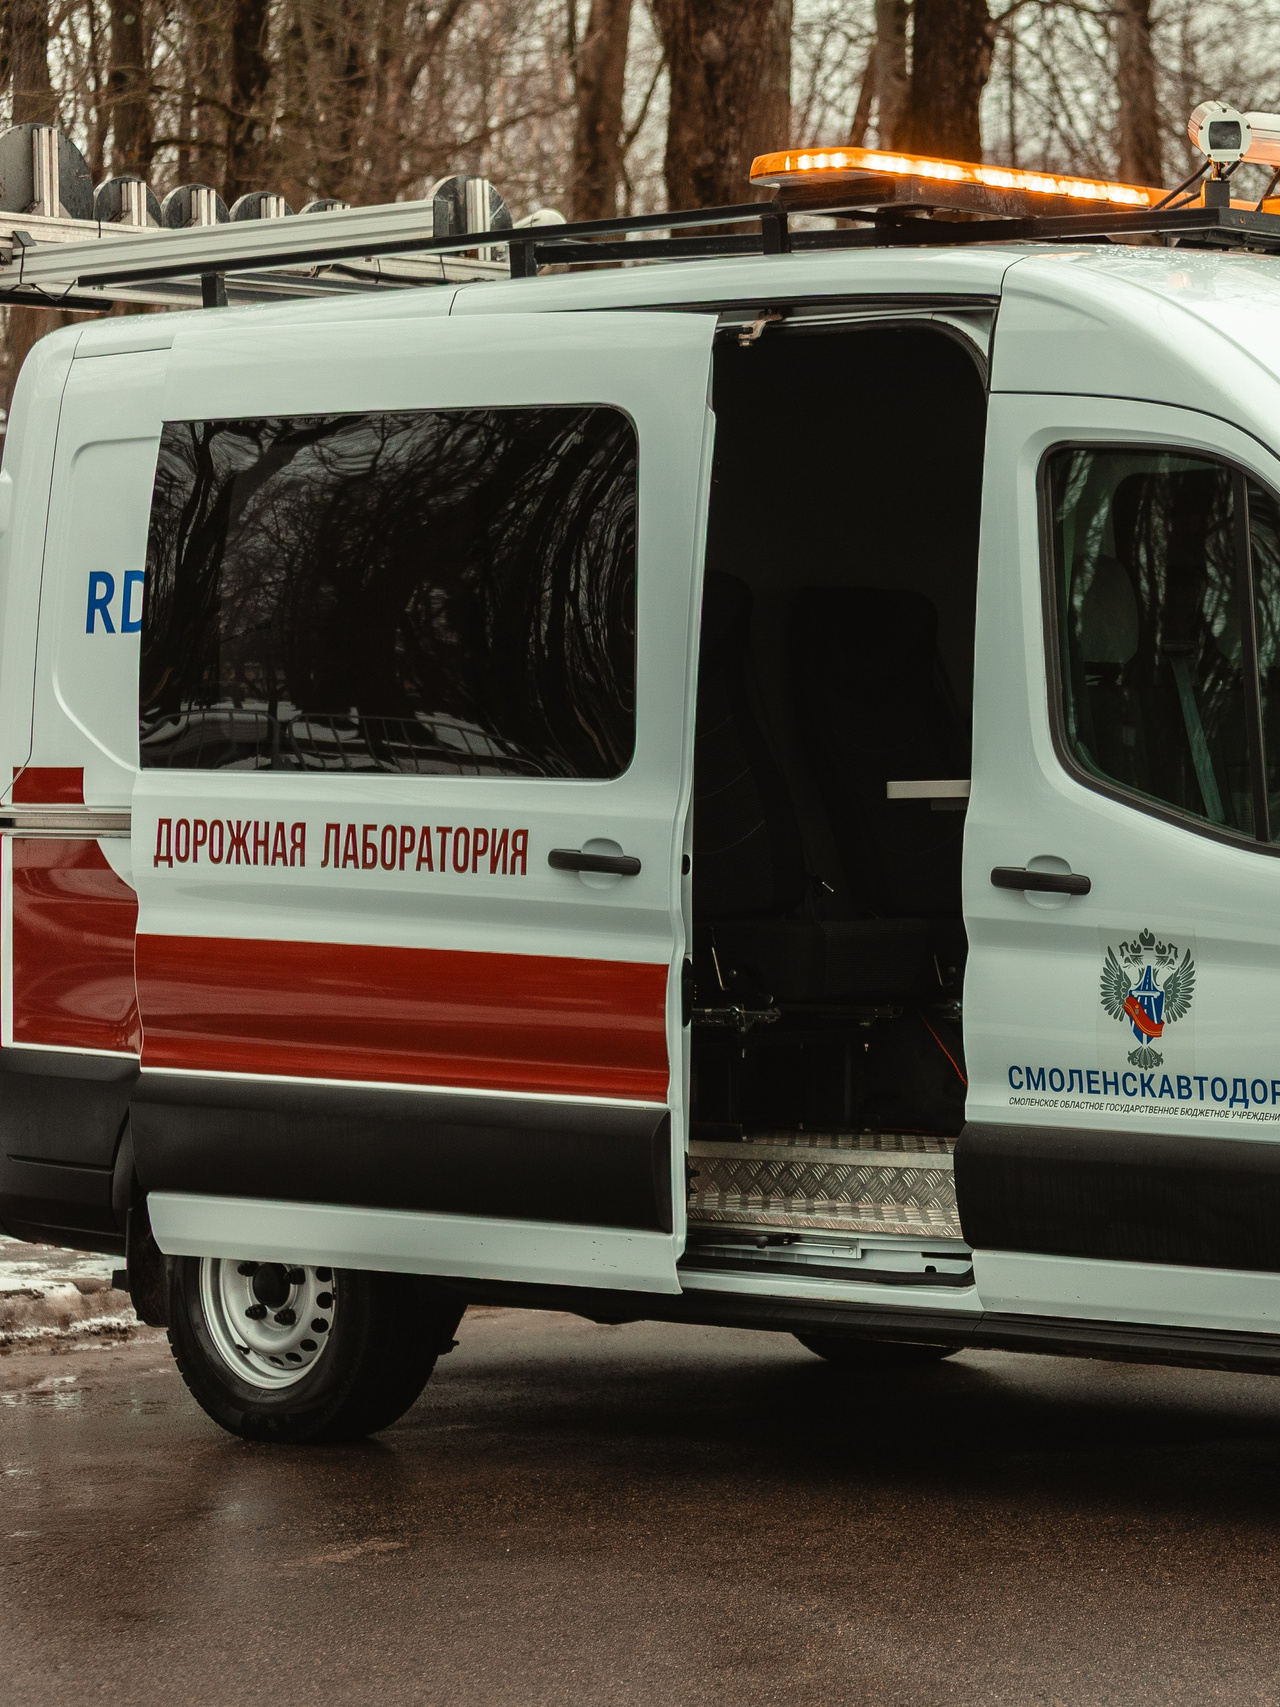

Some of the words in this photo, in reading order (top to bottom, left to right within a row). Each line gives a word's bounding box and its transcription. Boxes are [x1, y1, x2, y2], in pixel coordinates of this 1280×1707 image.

[153, 818, 306, 869] ДОРОЖНАЯ
[321, 822, 529, 876] ЛАБОРАТОРИЯ
[1009, 1097, 1059, 1108] СМОЛЕНСКОЕ
[1060, 1100, 1104, 1111] ОБЛАСТНОЕ
[1105, 1102, 1179, 1116] ГОСУДАРСТВЕННОЕ
[1180, 1107, 1230, 1119] БЮДЖЕТНОЕ
